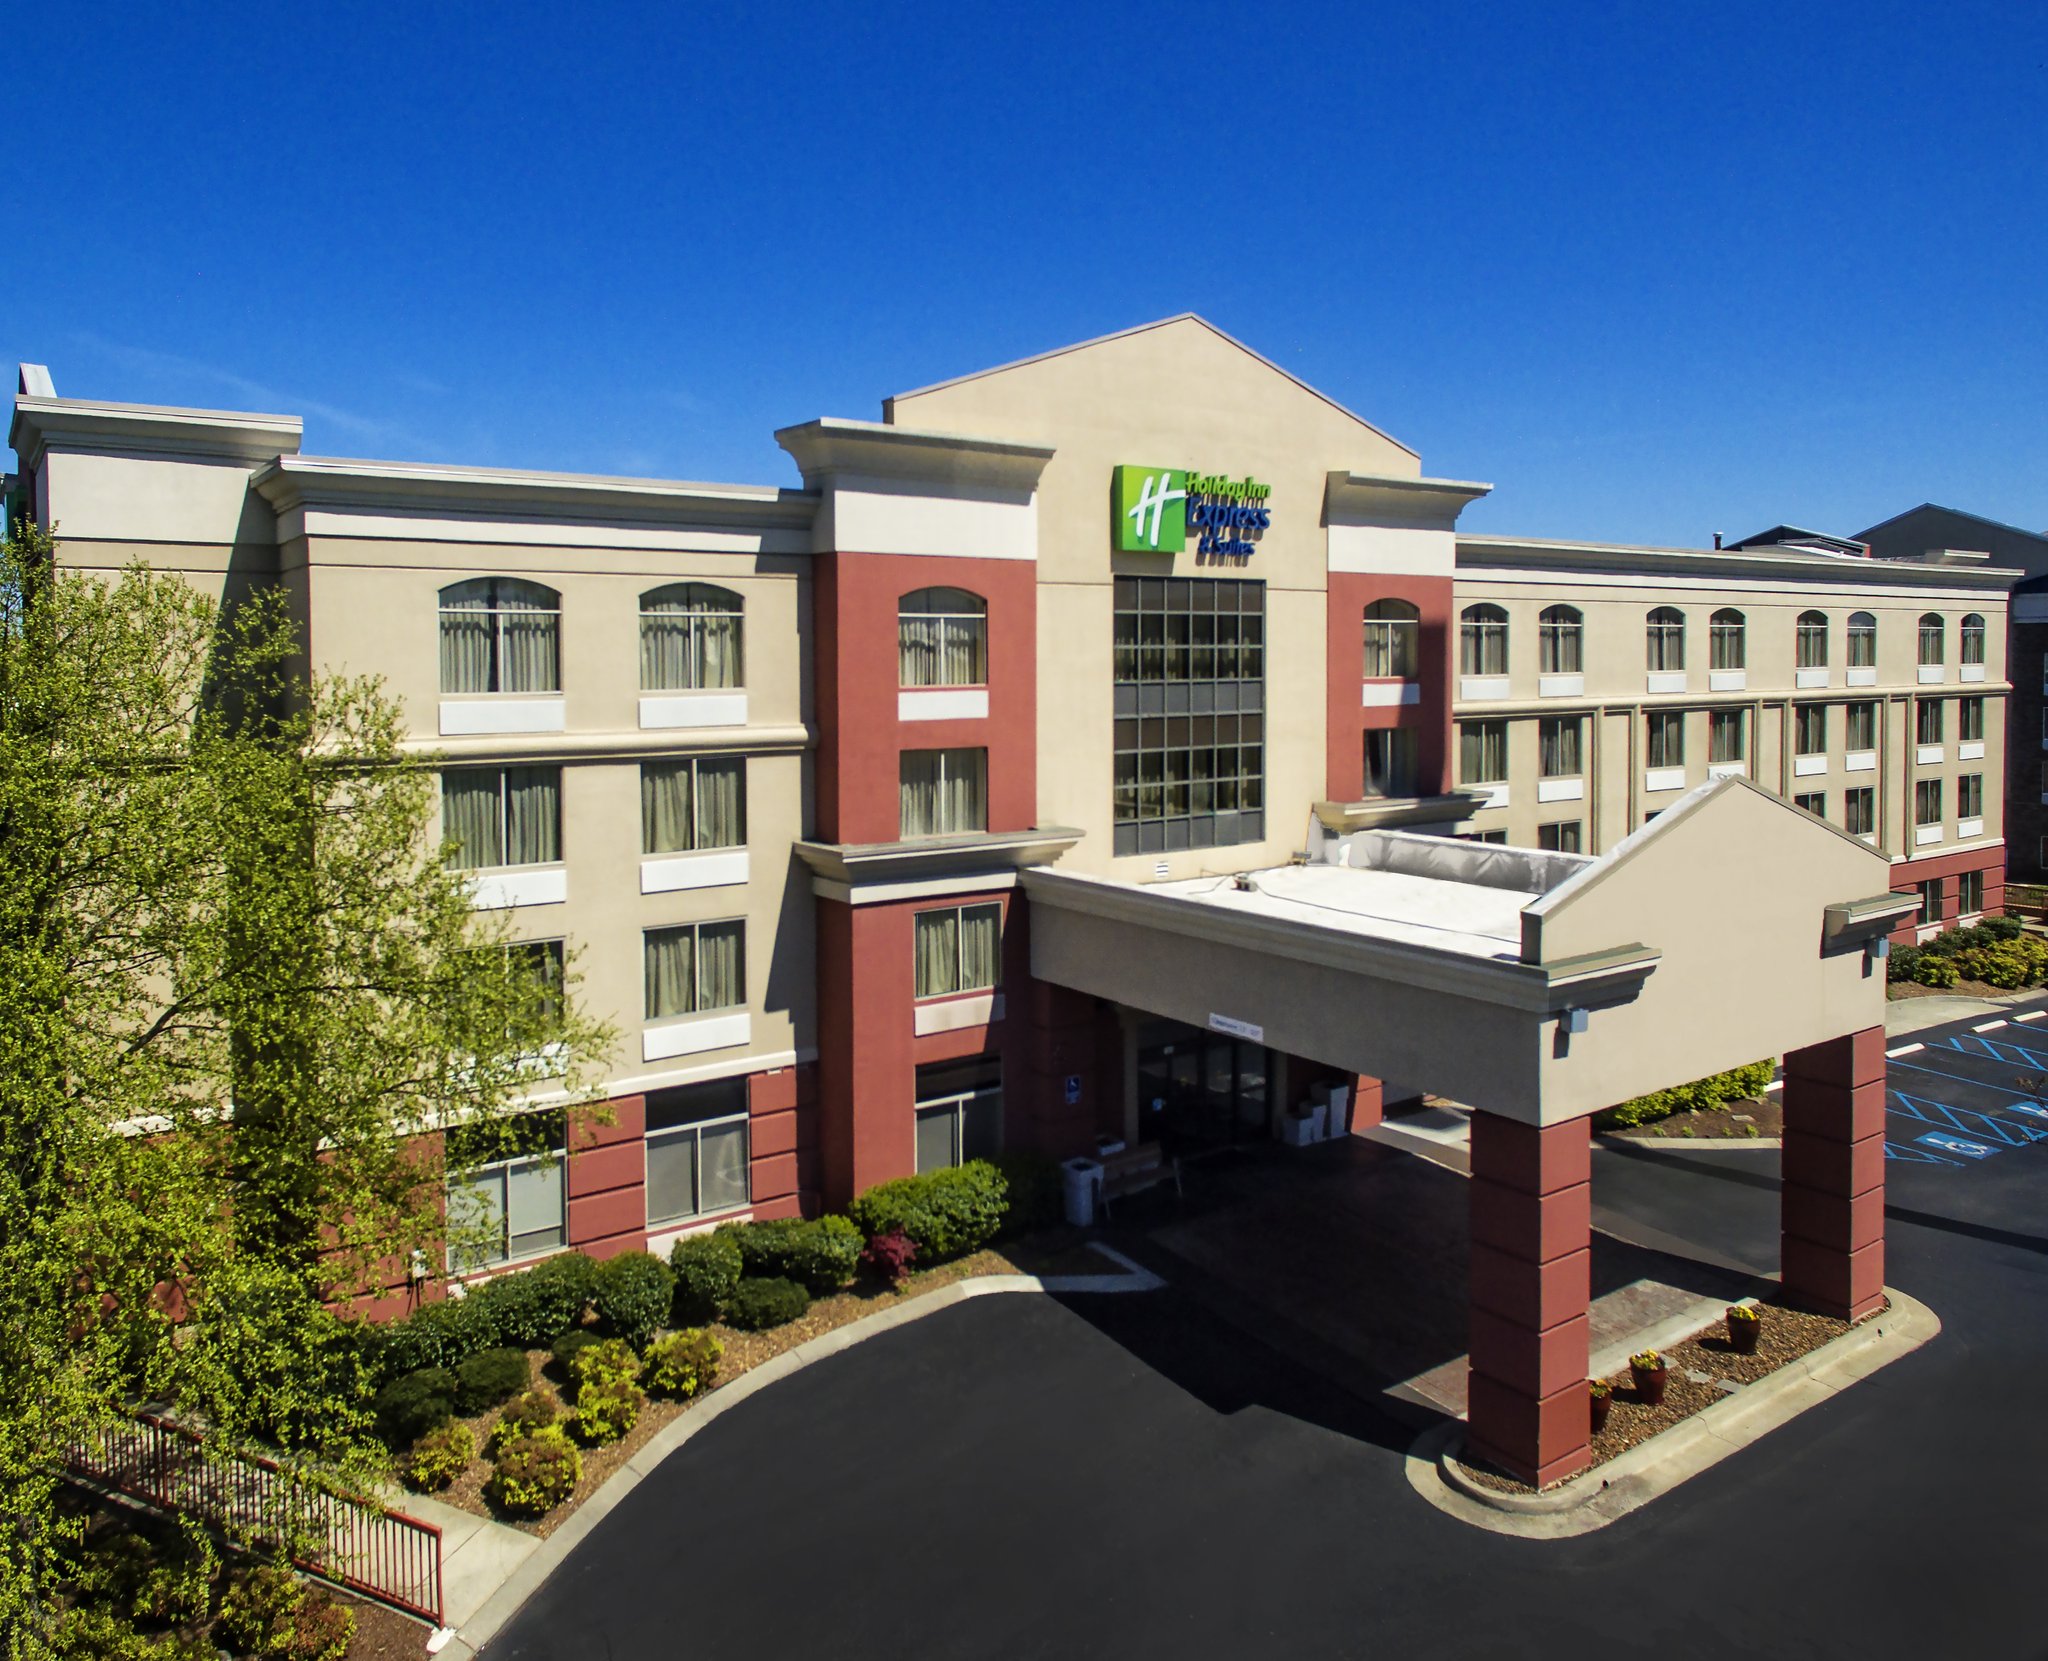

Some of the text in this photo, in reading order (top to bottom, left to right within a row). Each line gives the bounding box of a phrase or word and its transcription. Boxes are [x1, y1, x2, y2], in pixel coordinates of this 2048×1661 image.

[1186, 472, 1271, 500] Holiday Inn
[1128, 473, 1186, 546] H
[1187, 497, 1271, 535] Express
[1213, 537, 1256, 556] Suites
